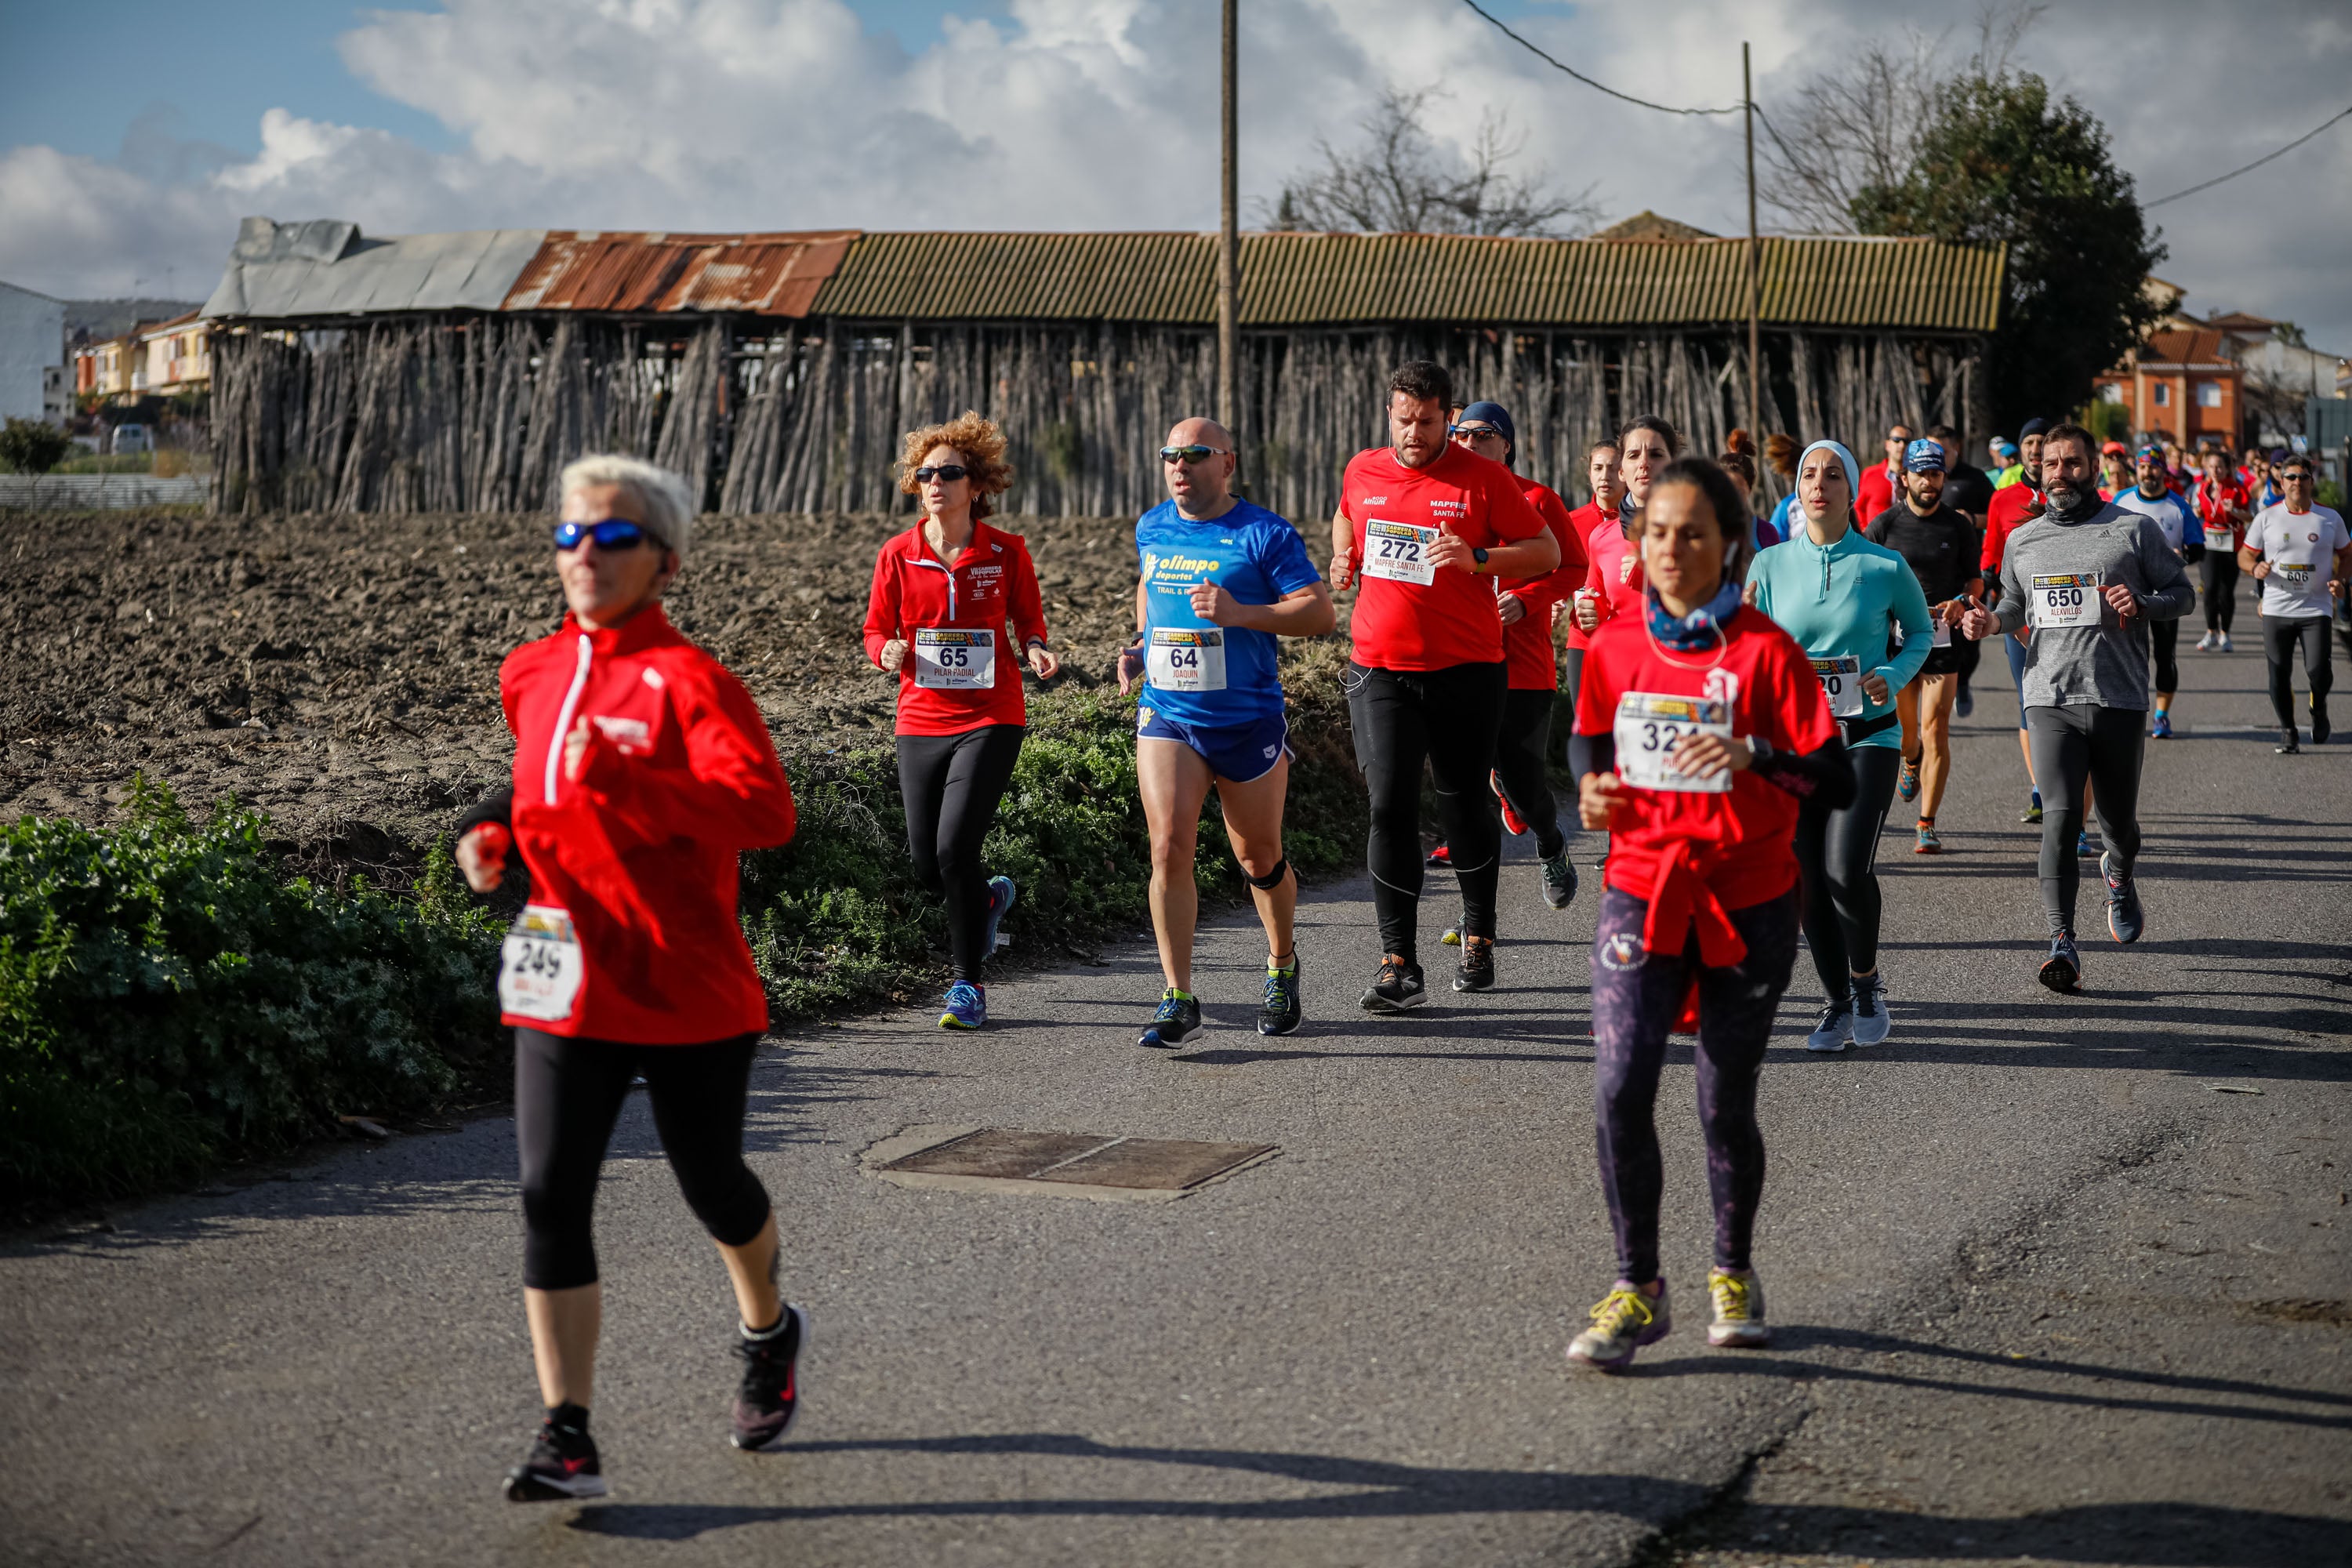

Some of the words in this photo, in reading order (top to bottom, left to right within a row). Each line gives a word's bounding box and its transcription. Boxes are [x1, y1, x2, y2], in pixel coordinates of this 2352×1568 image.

[1430, 500, 1467, 510] MAPFRE
[1380, 539, 1420, 562] 272
[1160, 554, 1219, 574] olimpo
[1375, 558, 1396, 568] MAPFRE
[1396, 561, 1415, 572] SANTA
[1156, 571, 1192, 581] deportes
[2288, 572, 2309, 582] 606
[2047, 588, 2082, 607] 650
[2051, 607, 2082, 616] ALEXVILLOS
[940, 648, 968, 667] 65
[1171, 648, 1198, 668] 64
[953, 668, 975, 677] PADIAL
[1173, 670, 1198, 678] JOAQUIN
